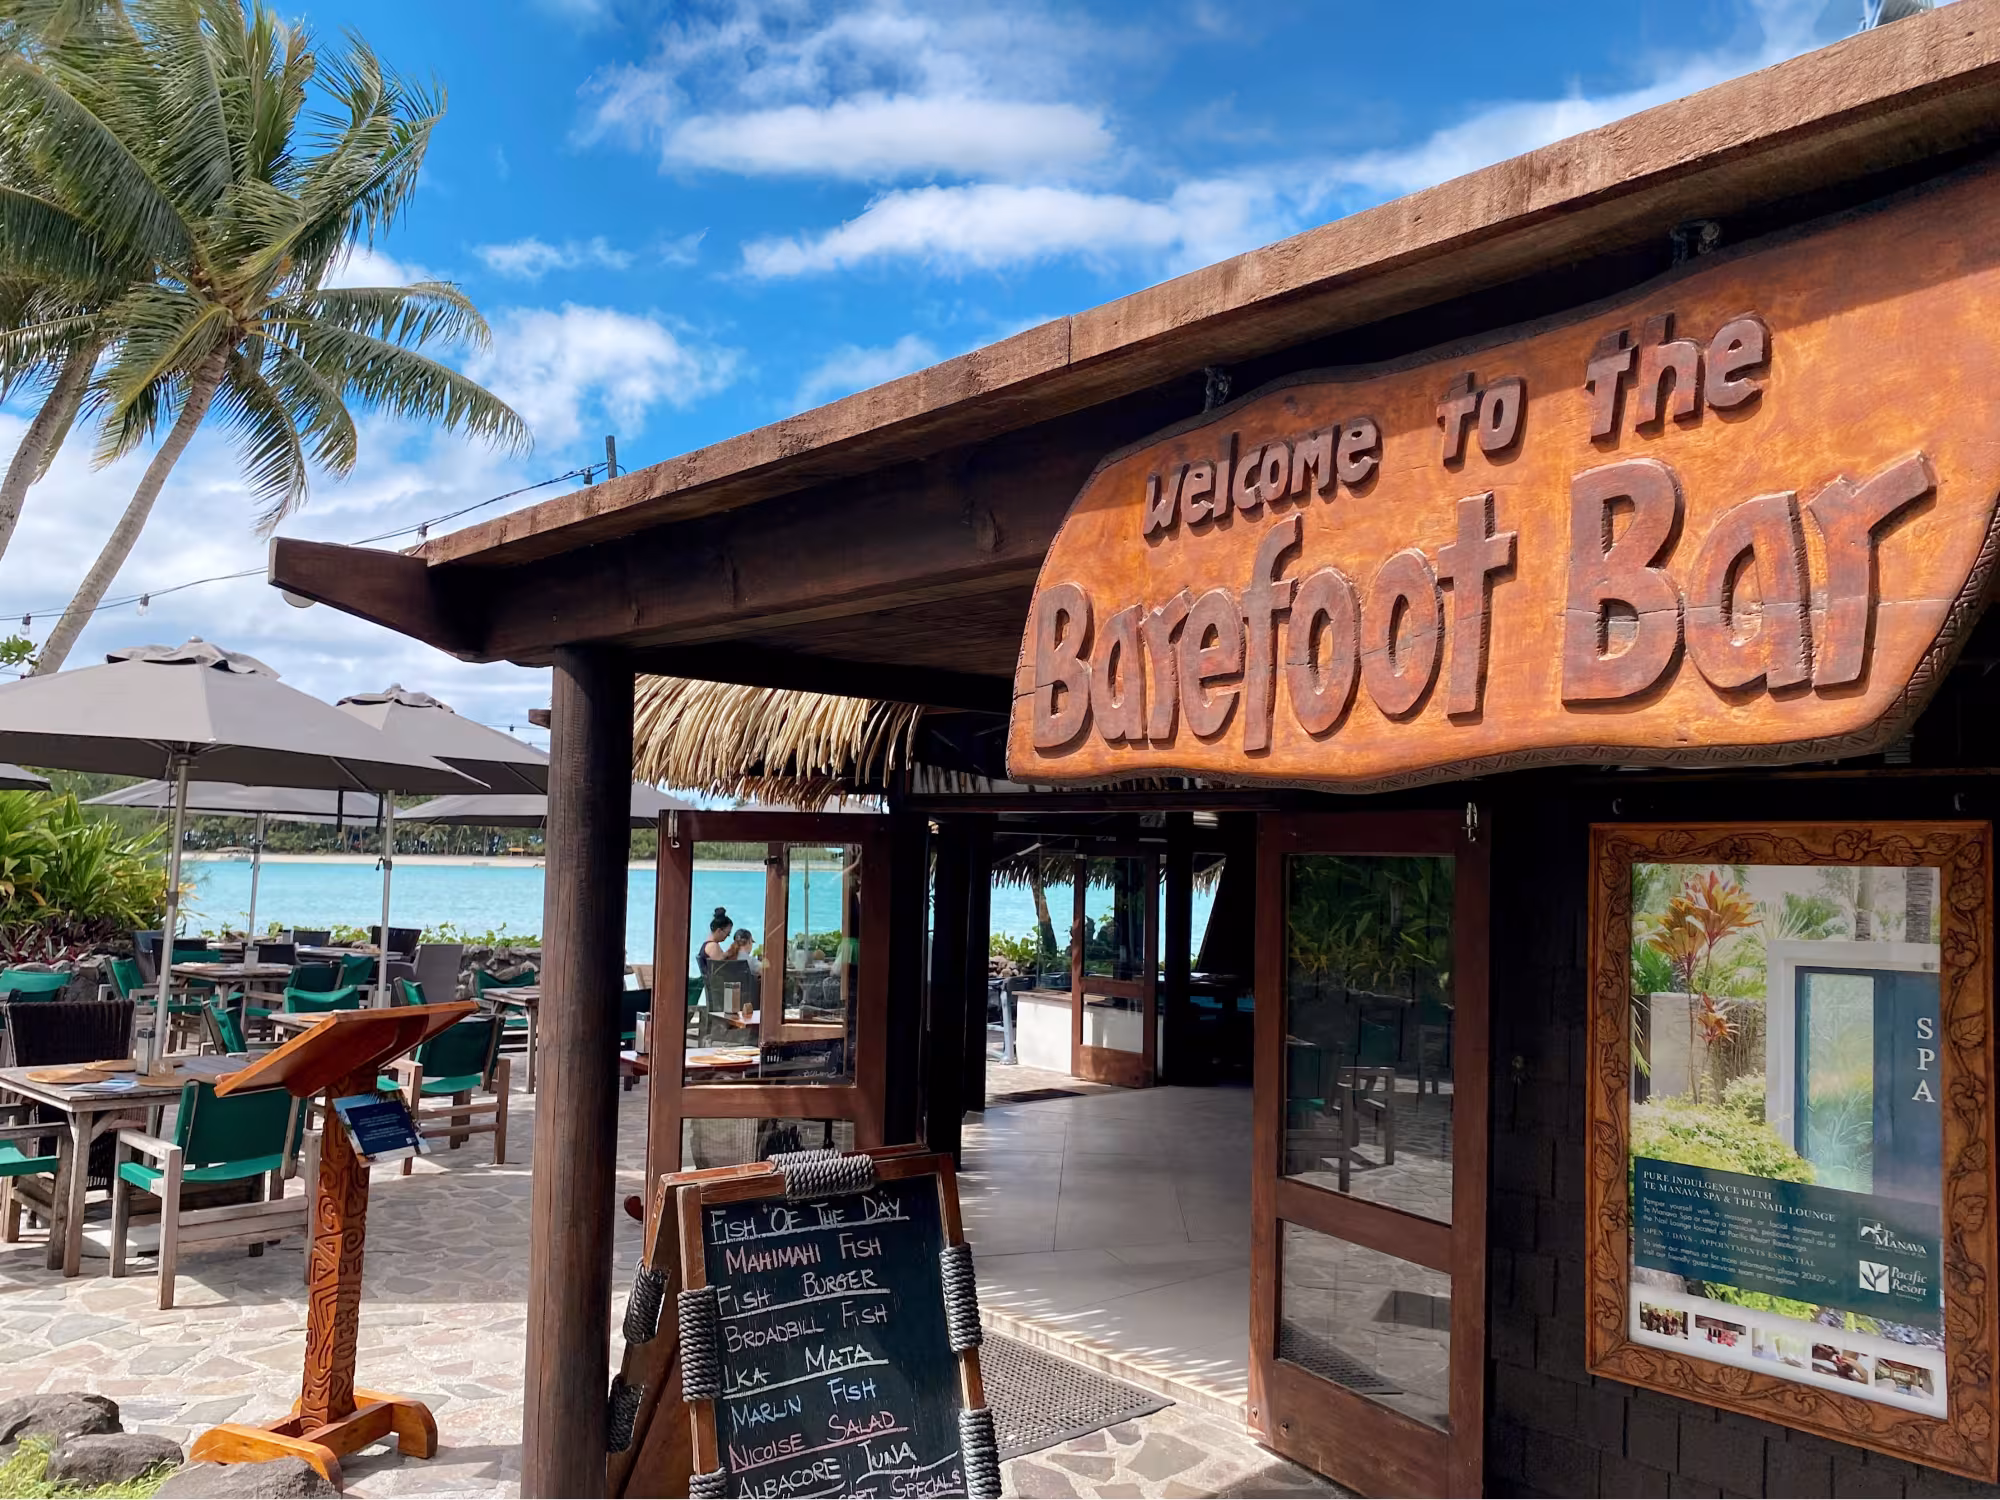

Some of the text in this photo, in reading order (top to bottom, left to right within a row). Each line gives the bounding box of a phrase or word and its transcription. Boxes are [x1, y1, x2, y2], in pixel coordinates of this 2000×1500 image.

[1436, 372, 1525, 466] to
[1585, 312, 1772, 443] the
[1032, 452, 1935, 752] Barefoot Bar
[1644, 1171, 1771, 1200] PURE INDULGENCE WITH
[1644, 1181, 1656, 1190] TE
[1659, 1184, 1700, 1198] MANAVA
[1704, 1192, 1721, 1202] SPA
[1734, 1198, 1756, 1208] THE
[1760, 1202, 1785, 1213] NAIL
[1789, 1207, 1836, 1222] LOUNGE
[710, 1196, 900, 1241] FISH OF THE DAY
[726, 1233, 882, 1275] MAHIMAHI FISH
[1644, 1228, 1663, 1236] OPEN
[1673, 1233, 1692, 1242] DAYS
[1701, 1239, 1765, 1256] APPOINTMENTS
[1768, 1252, 1815, 1267] ESSENTIAL
[1876, 1234, 1927, 1254] MANAVA
[717, 1269, 878, 1315] FISH BURGER
[1892, 1267, 1927, 1285] Pacific
[1892, 1279, 1927, 1296] Resort
[725, 1301, 888, 1353] BROADBILL FISH
[805, 1344, 874, 1373] MATA
[731, 1378, 876, 1434] MARLIN FISH
[728, 1411, 895, 1472] NICOISE SALAD
[738, 1440, 917, 1499] ALBACORE TUNA
[890, 1469, 961, 1499] SPECIALS
